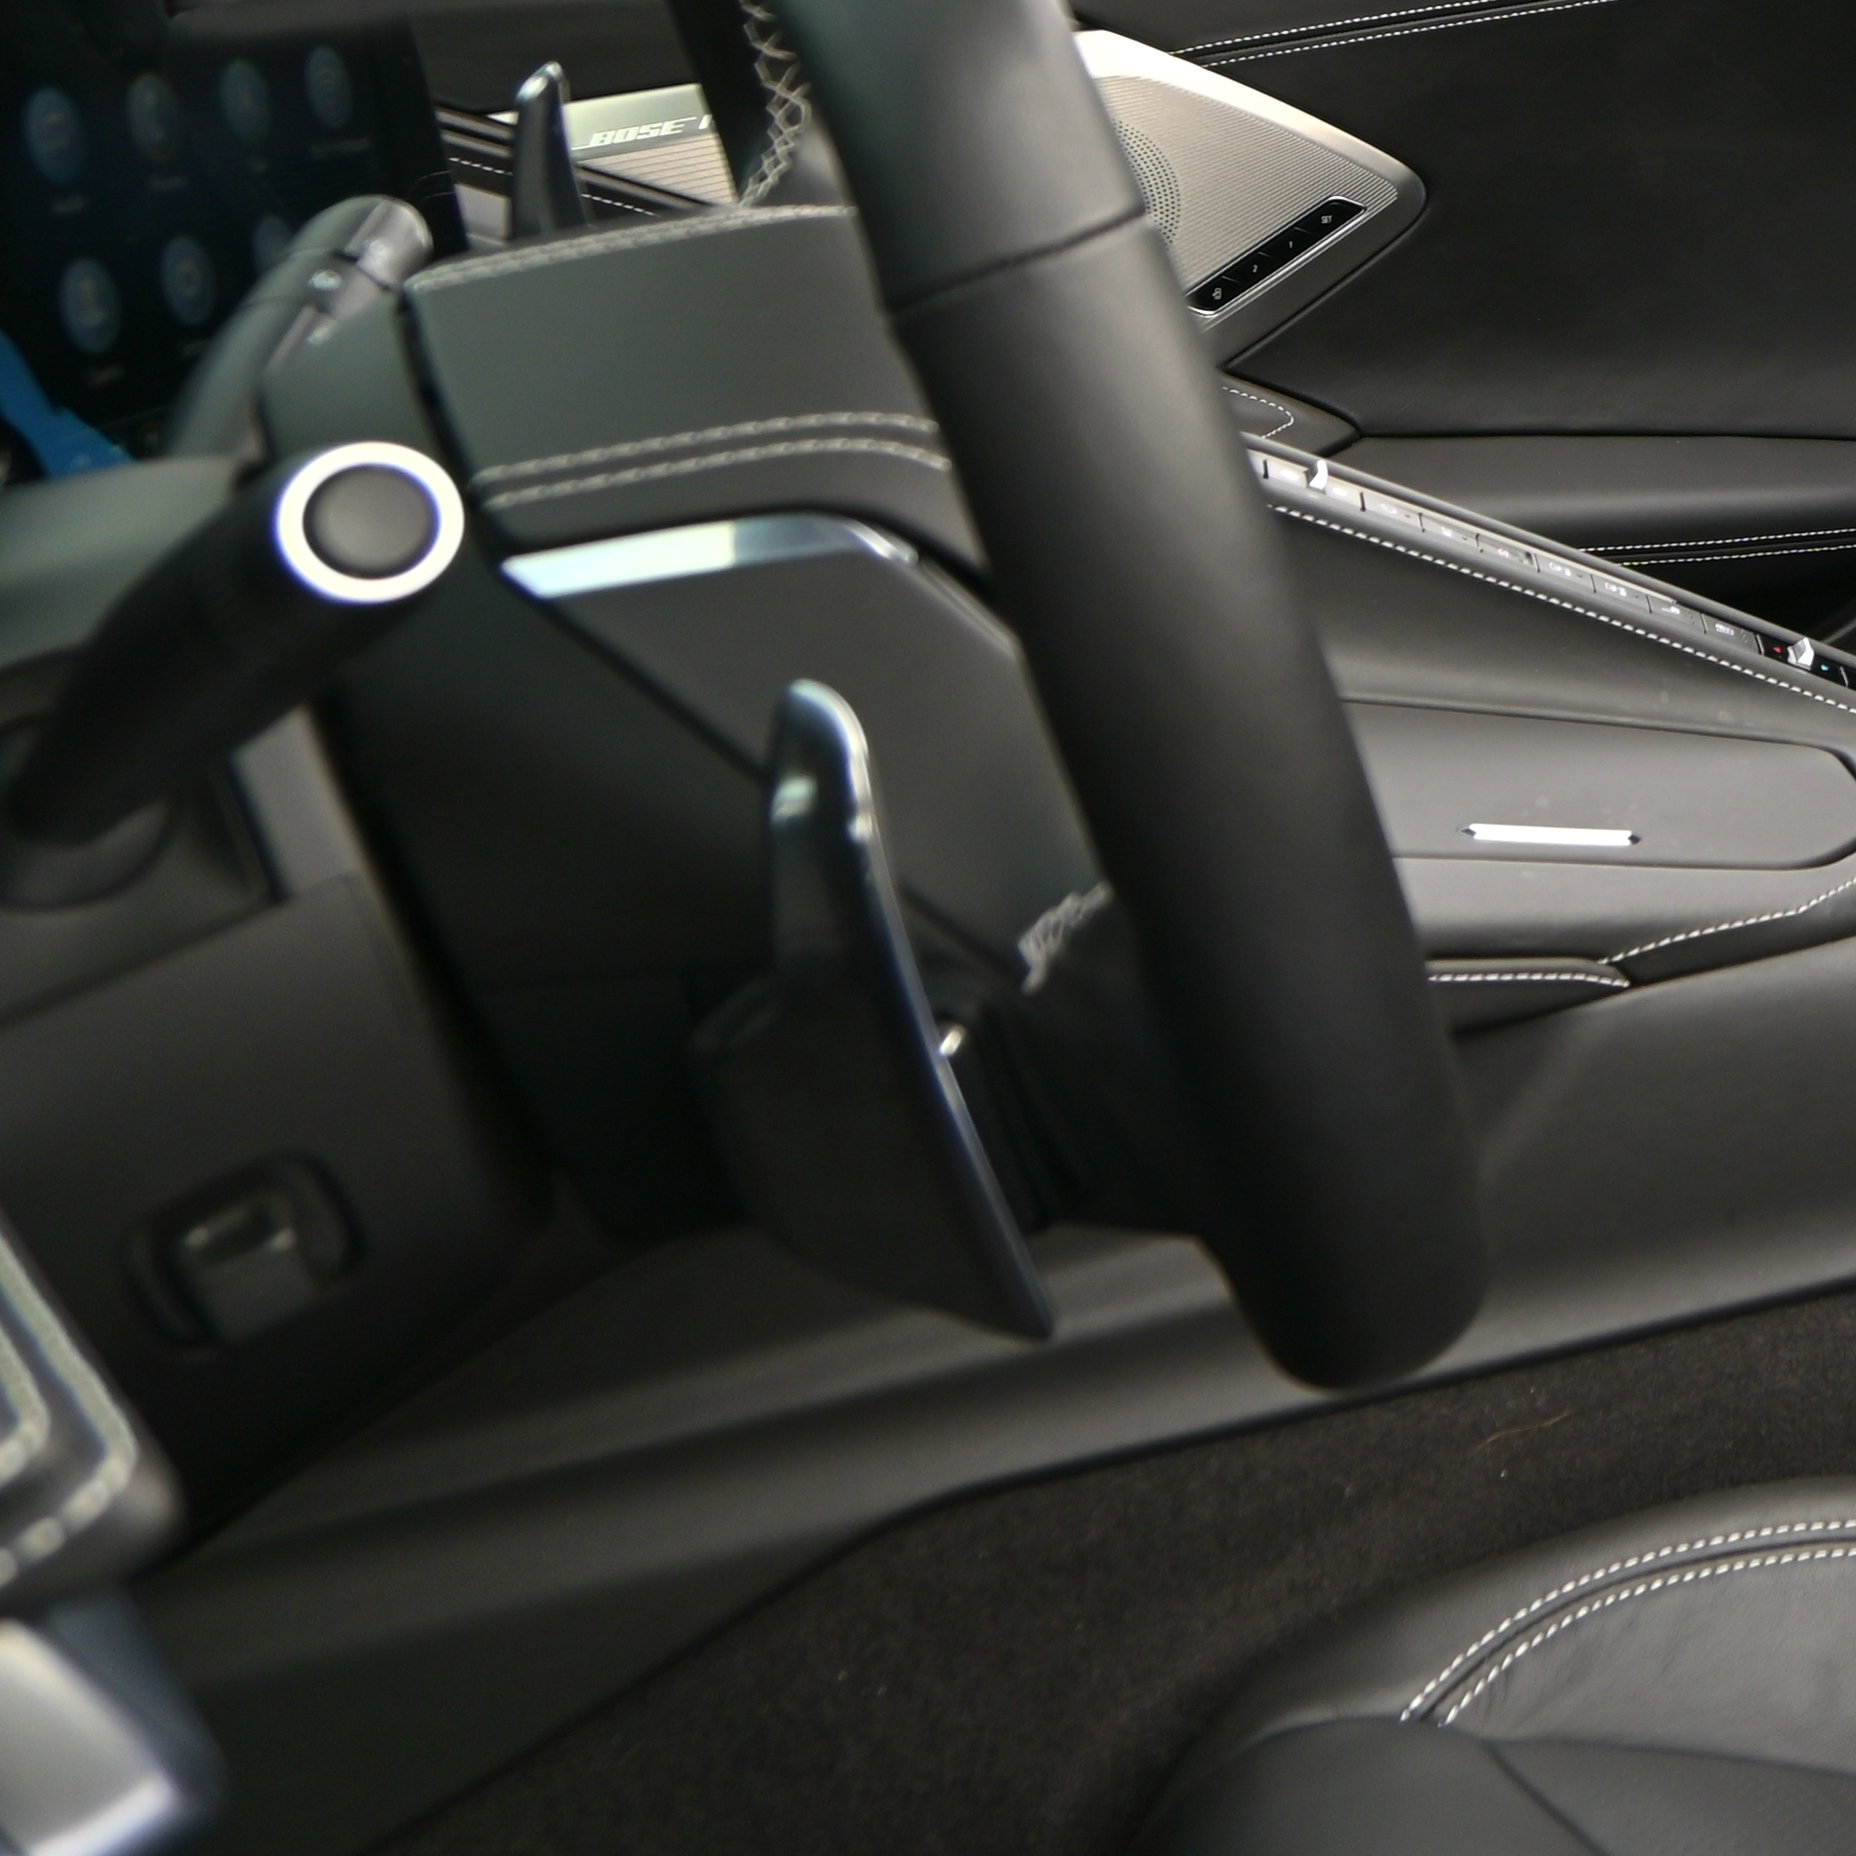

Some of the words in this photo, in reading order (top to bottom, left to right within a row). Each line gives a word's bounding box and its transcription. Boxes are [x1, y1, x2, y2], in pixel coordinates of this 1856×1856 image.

[572, 116, 697, 150] BOSE
[1320, 215, 1333, 224] SET
[1288, 240, 1294, 249] 1
[1252, 264, 1259, 273] 2
